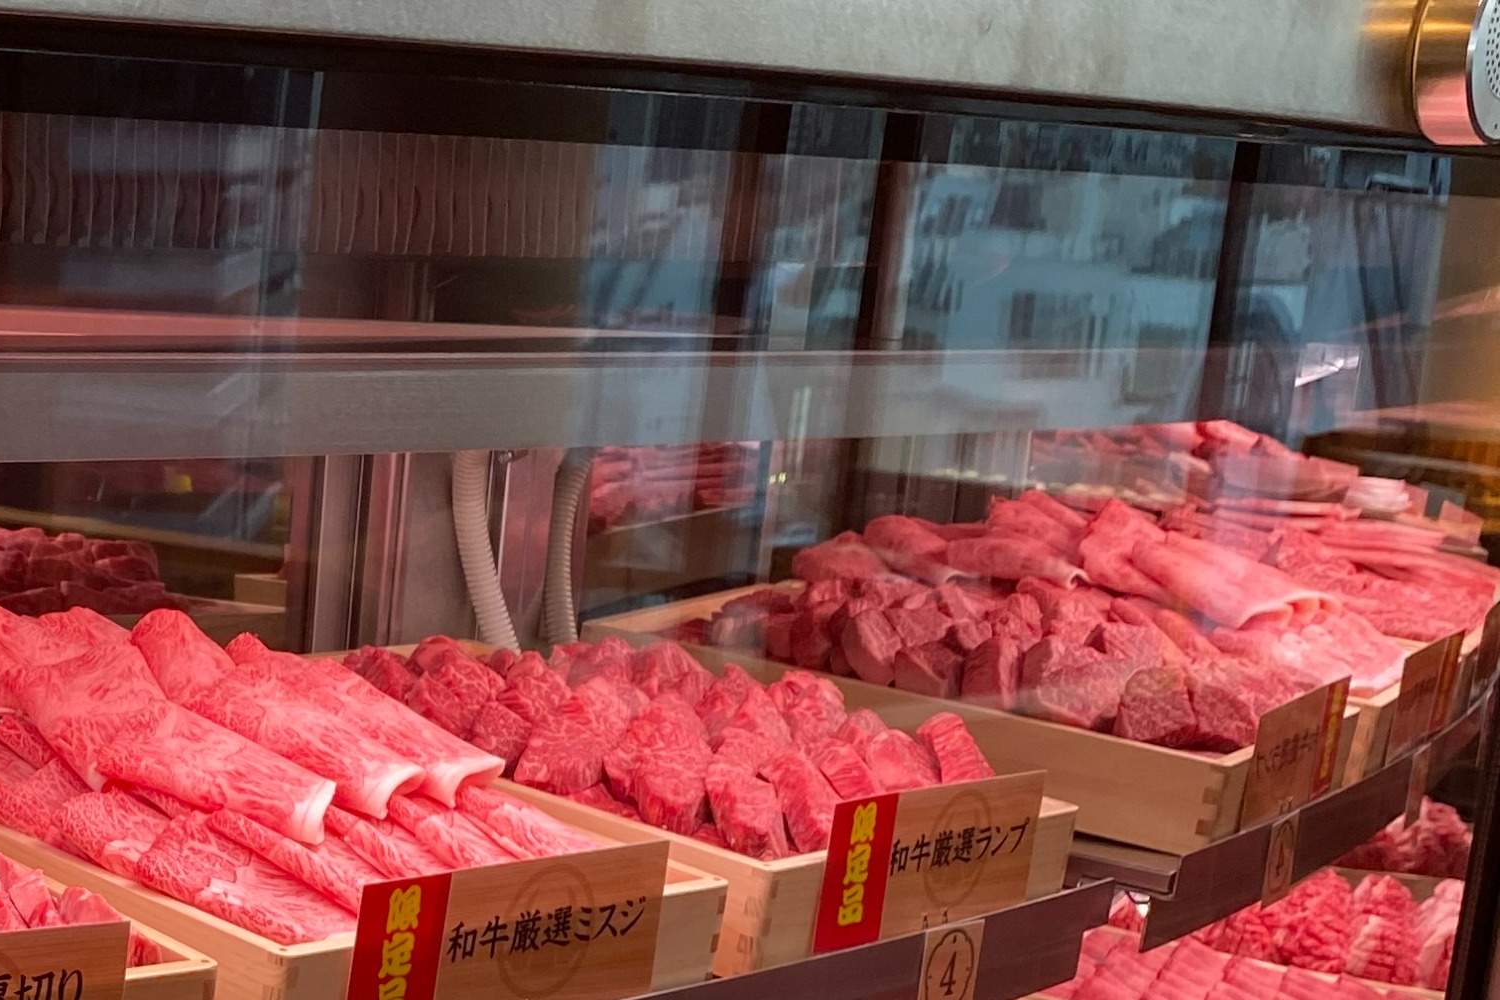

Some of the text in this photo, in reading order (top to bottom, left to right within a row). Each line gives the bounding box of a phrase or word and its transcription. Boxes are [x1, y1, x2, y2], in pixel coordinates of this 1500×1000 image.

[891, 817, 1030, 876] 和牛厳選ランプ
[447, 896, 646, 963] 和牛厳選ミスジ
[940, 951, 957, 996] 4
